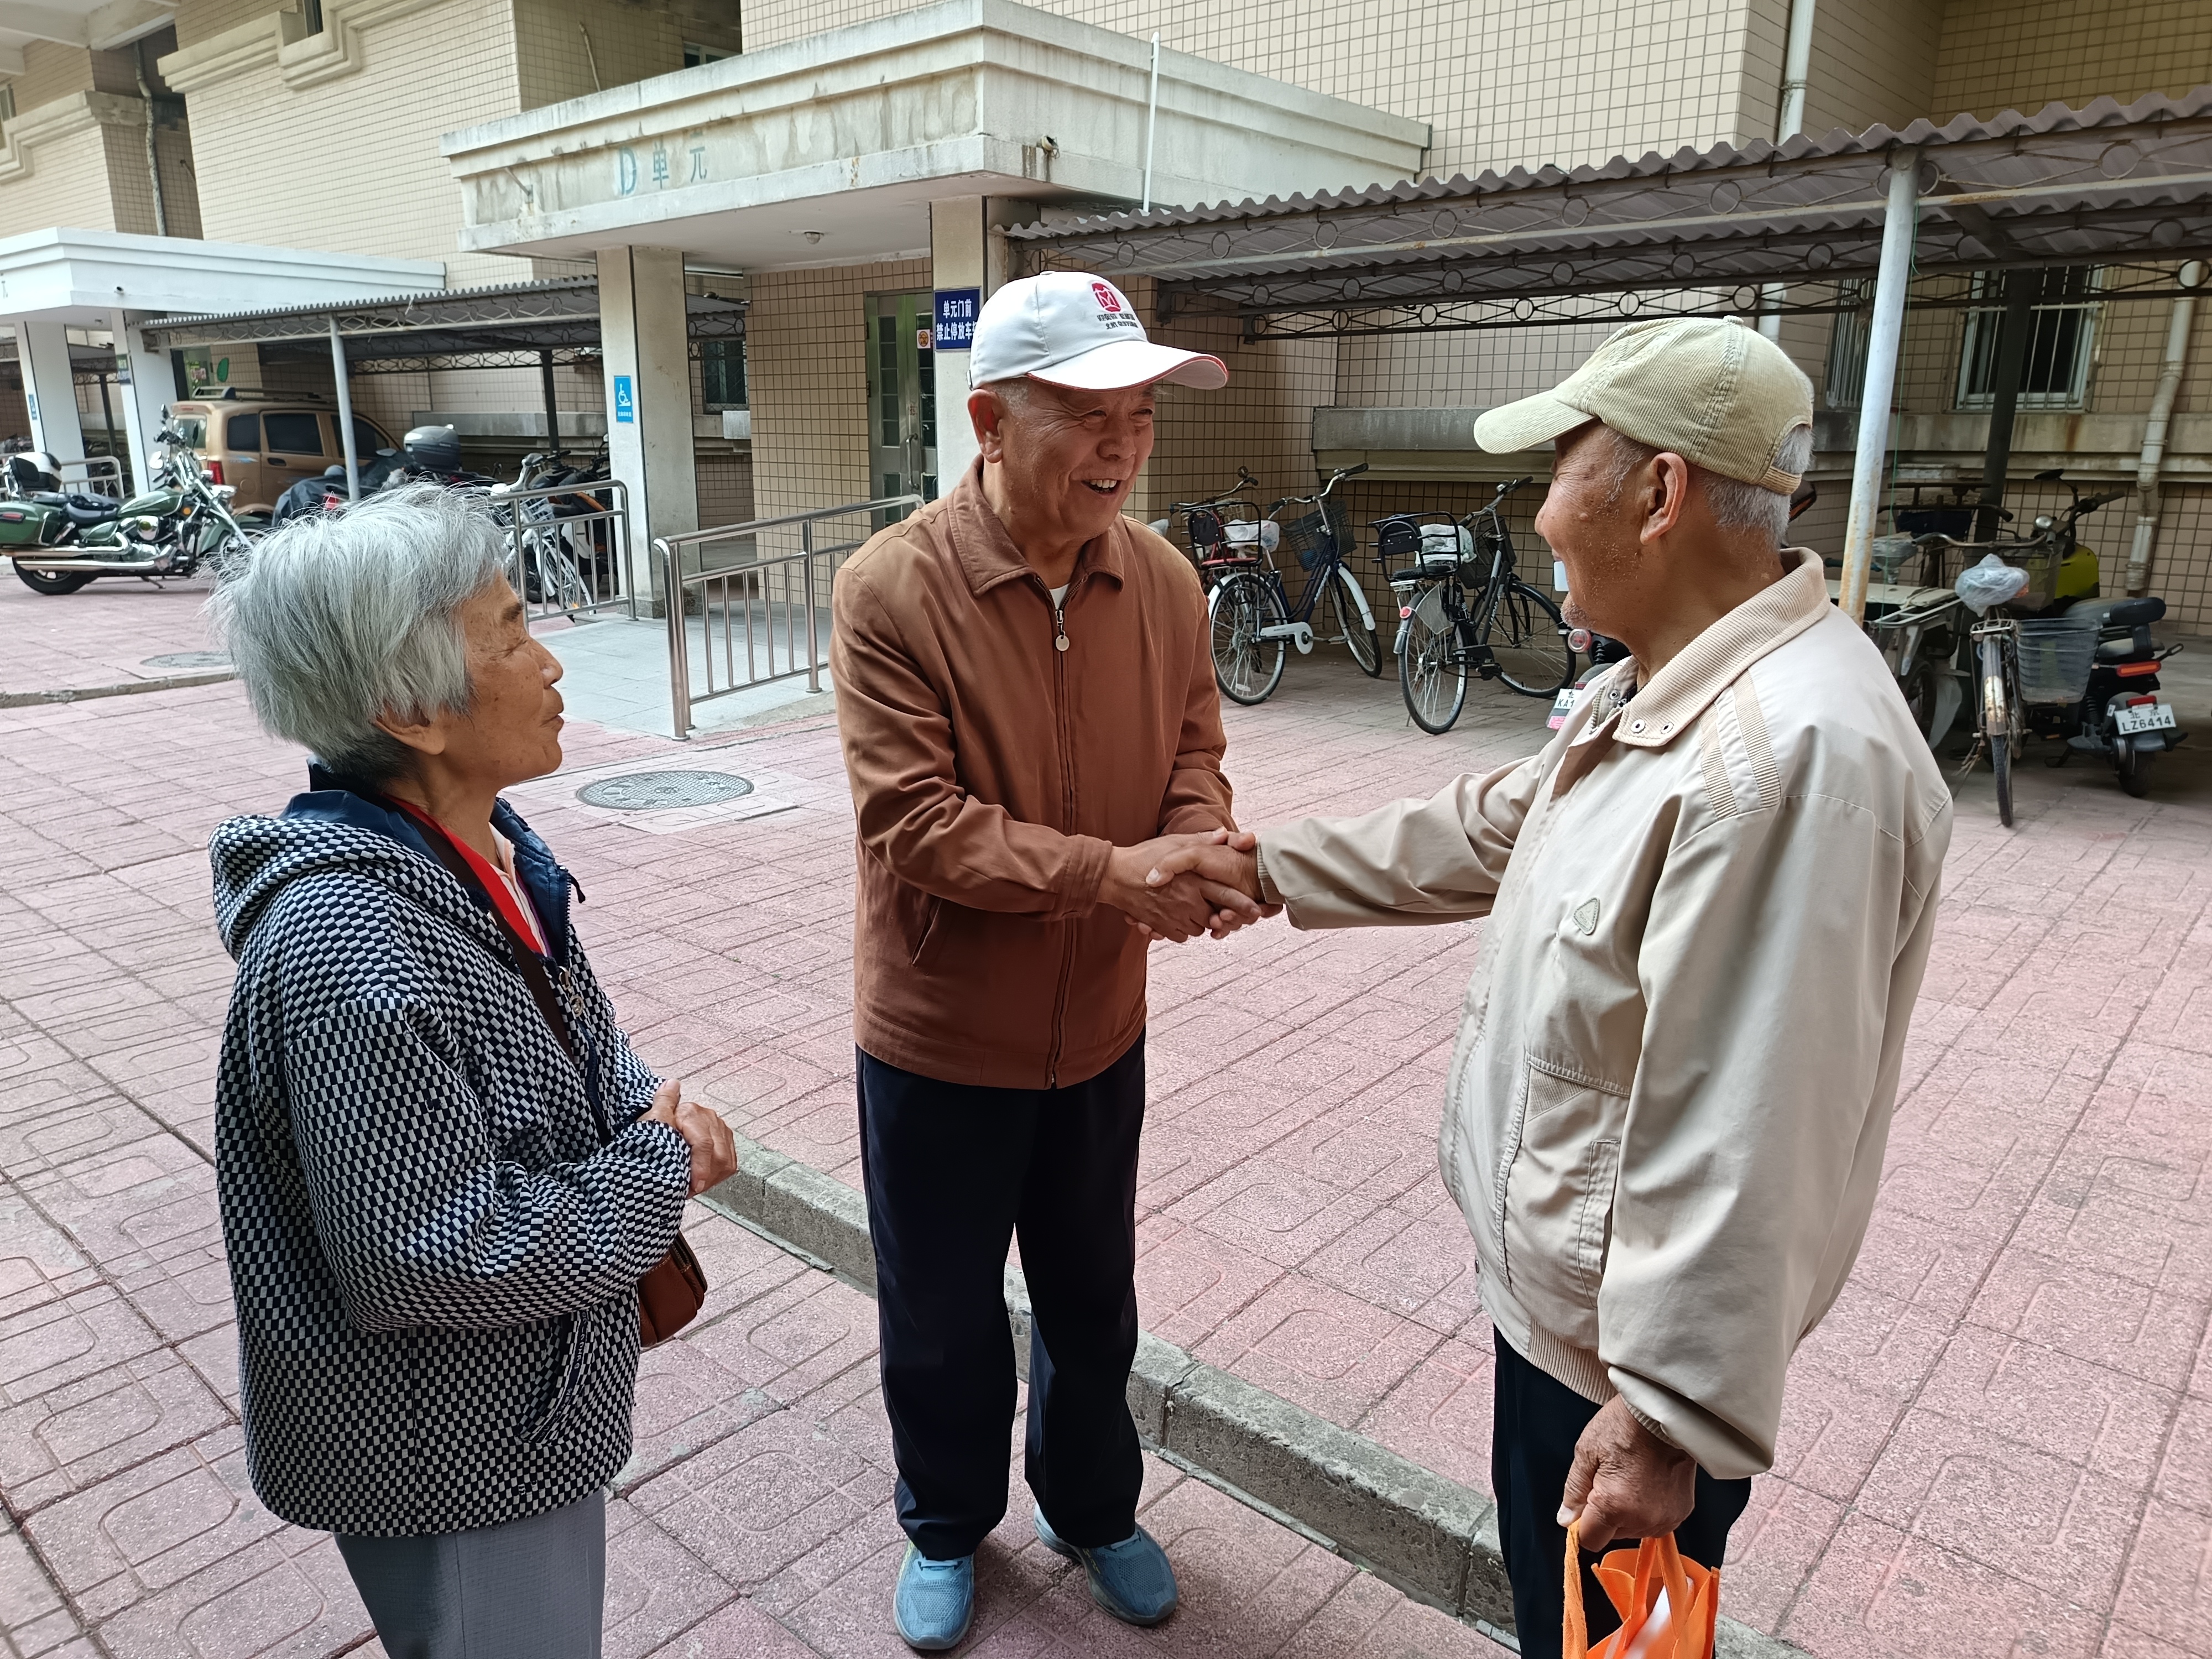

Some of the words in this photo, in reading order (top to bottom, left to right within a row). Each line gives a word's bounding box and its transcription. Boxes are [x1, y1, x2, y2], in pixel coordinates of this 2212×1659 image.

[943, 299, 972, 319] 单元门前
[2122, 716, 2171, 732] LZ6414
